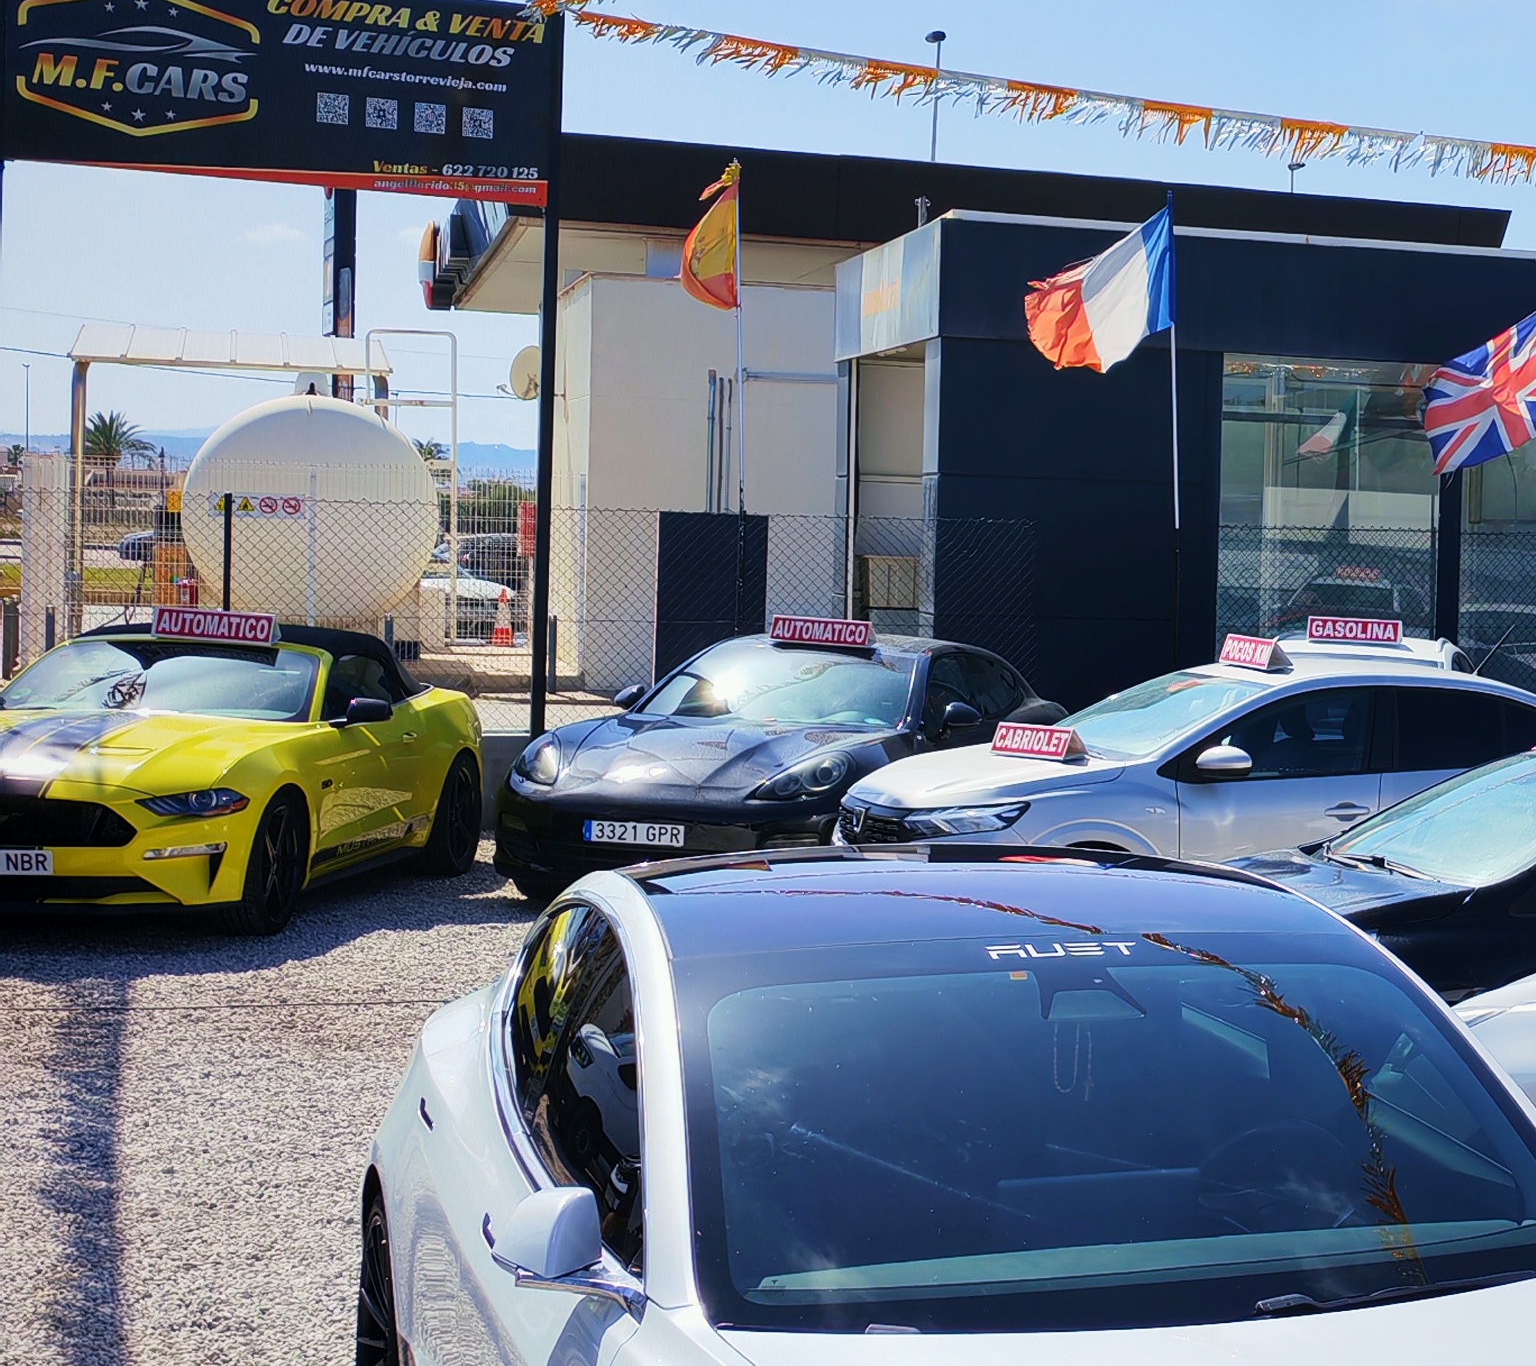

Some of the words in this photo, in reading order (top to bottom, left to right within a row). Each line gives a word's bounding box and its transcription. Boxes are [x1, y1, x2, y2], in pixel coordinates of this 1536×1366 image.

[415, 10, 441, 32] &
[449, 13, 546, 44] VENTA
[282, 24, 332, 48] DE
[333, 30, 515, 67] VEHÍCULOS
[304, 62, 508, 92] www.mfcarstorrevieja.com
[373, 160, 428, 174] Ventas
[442, 164, 473, 177] 622
[477, 165, 508, 178] 720
[512, 167, 538, 179] 125
[158, 611, 268, 640] AUTOMATICO
[773, 620, 866, 643] AUTOMATICO
[1311, 620, 1395, 640] GASOLINA
[1223, 639, 1255, 662] POCOS
[1253, 643, 1272, 664] KM
[995, 727, 1070, 754] CABRIOLET
[595, 823, 637, 841] 3321
[646, 826, 681, 844] GPR
[6, 853, 48, 871] NBR
